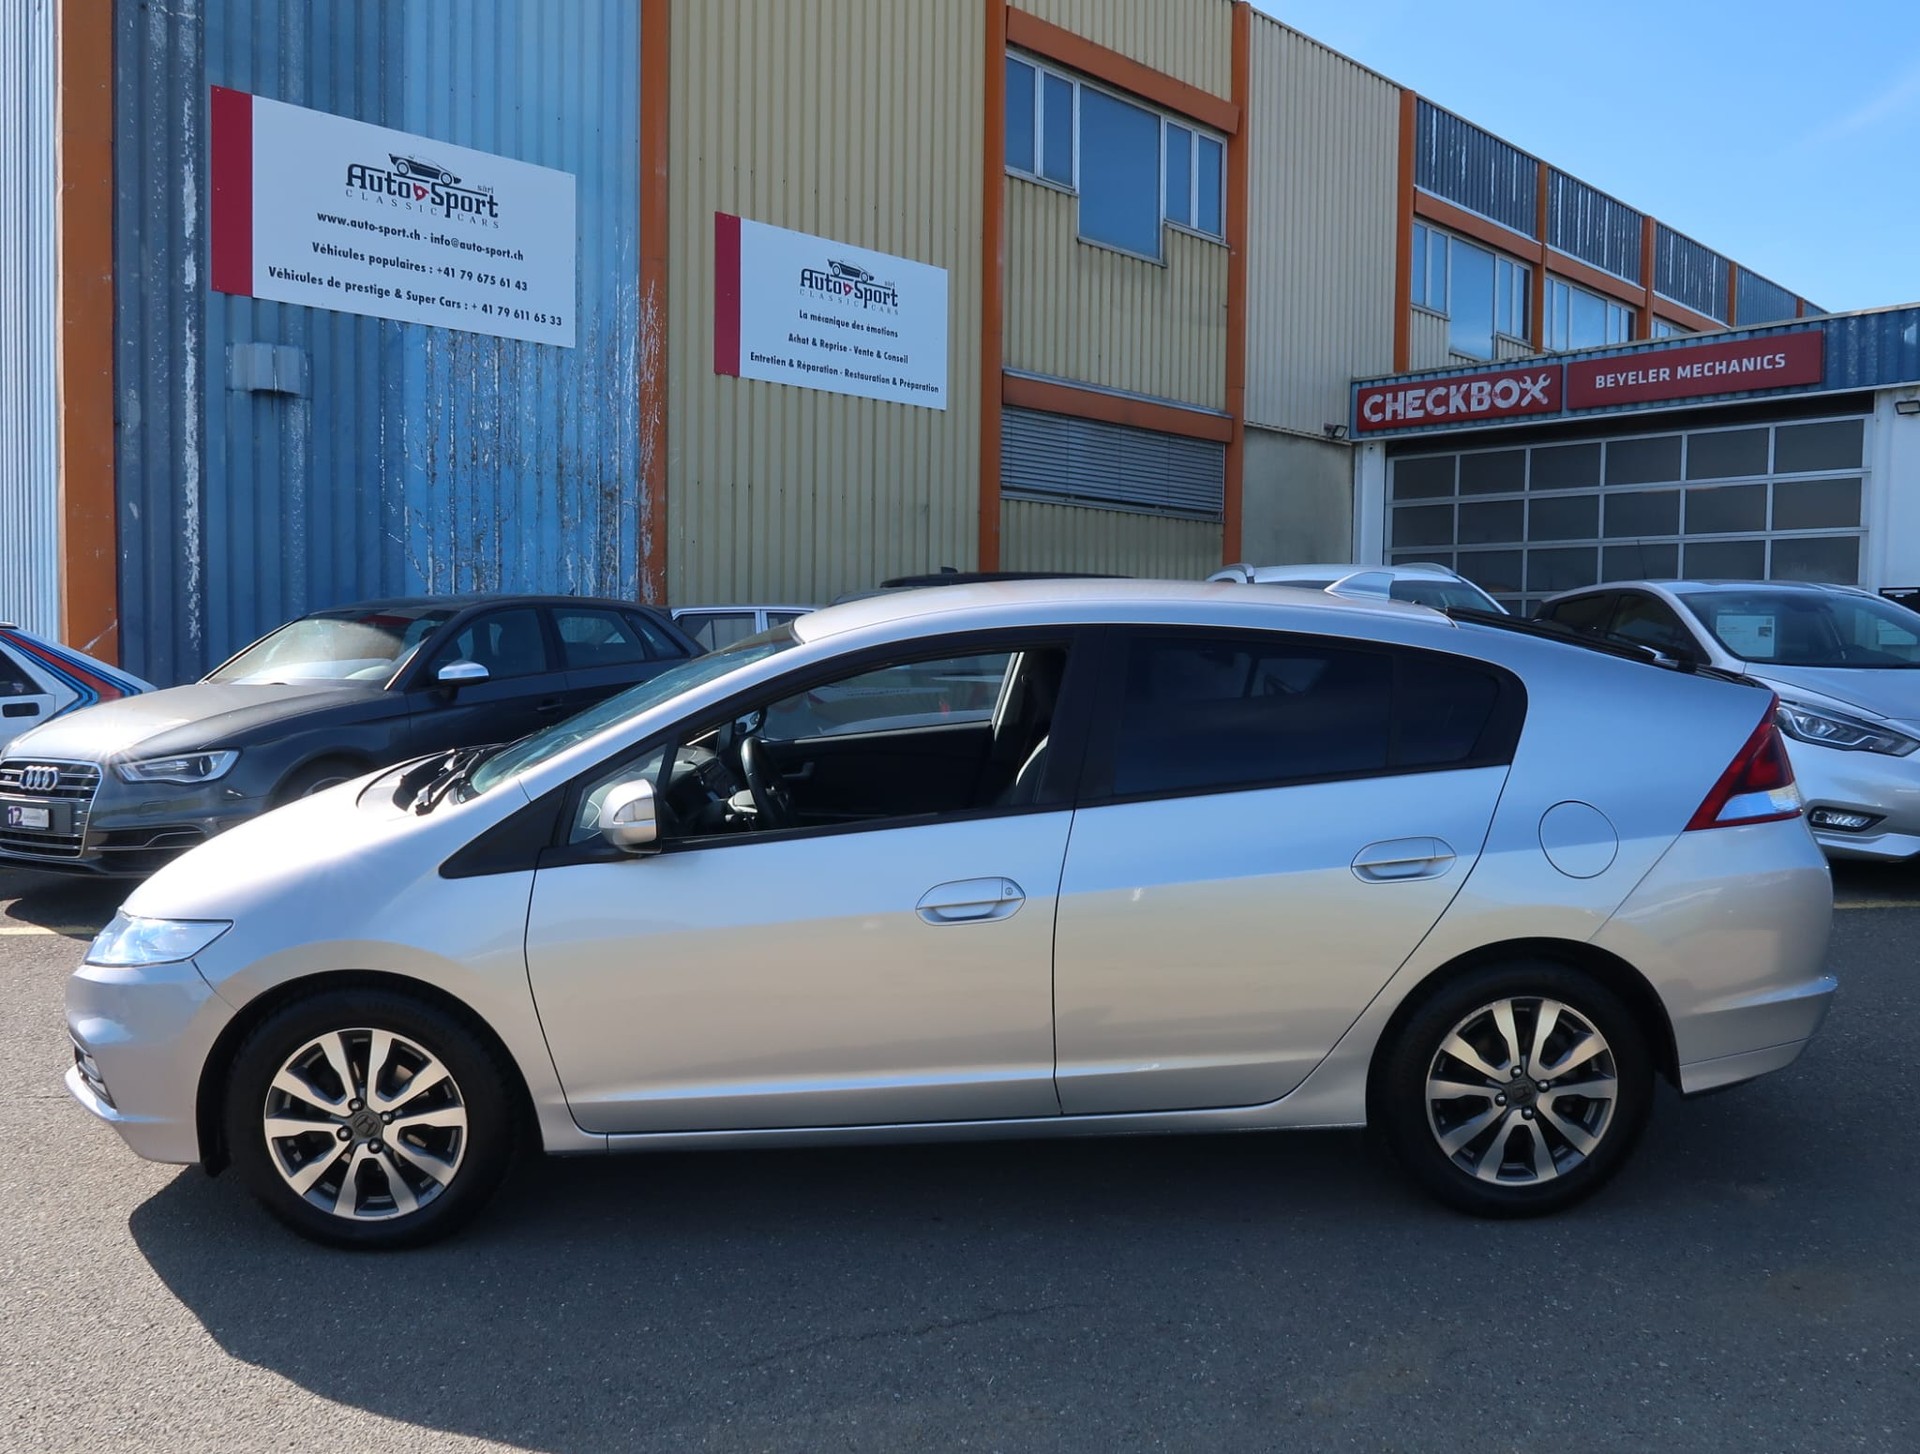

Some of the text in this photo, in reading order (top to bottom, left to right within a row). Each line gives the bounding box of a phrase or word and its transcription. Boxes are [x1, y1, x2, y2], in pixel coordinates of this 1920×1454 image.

[345, 189, 499, 229] CLASSIC CARS
[346, 163, 499, 219] Auto Sport
[317, 212, 421, 241] www.auto-sport.ch
[430, 232, 524, 261] info@auto-sport.ch
[312, 241, 365, 262] Véhicules
[368, 255, 426, 273] populaires
[437, 266, 456, 279] +41
[460, 269, 473, 282] 79
[477, 272, 497, 286] 675
[499, 277, 511, 289] 61
[515, 280, 528, 292] 43
[268, 265, 324, 286] Véhicules
[327, 276, 341, 289] de
[345, 281, 391, 299] prestige
[394, 288, 403, 300] &
[406, 289, 436, 306] Super
[439, 296, 462, 310] Cars
[481, 303, 494, 315] 41
[497, 305, 511, 318] 79
[514, 309, 530, 321] 611
[534, 312, 547, 324] 65
[549, 315, 562, 327] 33
[799, 289, 860, 308] CLASSIC
[800, 268, 899, 309] Auto Sport
[799, 309, 898, 338] La mécanique des émotions
[788, 333, 809, 346] Achat
[811, 337, 818, 347] &
[819, 339, 848, 353] Reprise
[853, 345, 874, 358] Vente
[876, 349, 882, 359] &
[883, 351, 909, 364] Conseil
[750, 352, 786, 367] Entretien
[788, 359, 795, 368] &
[797, 360, 838, 376] Réparation
[844, 368, 890, 385] Restauration
[891, 377, 898, 386] &
[899, 378, 939, 393] Préparation
[1595, 353, 1787, 389] BEYELER MECHANICS
[1363, 373, 1552, 424] CHECKBOX
